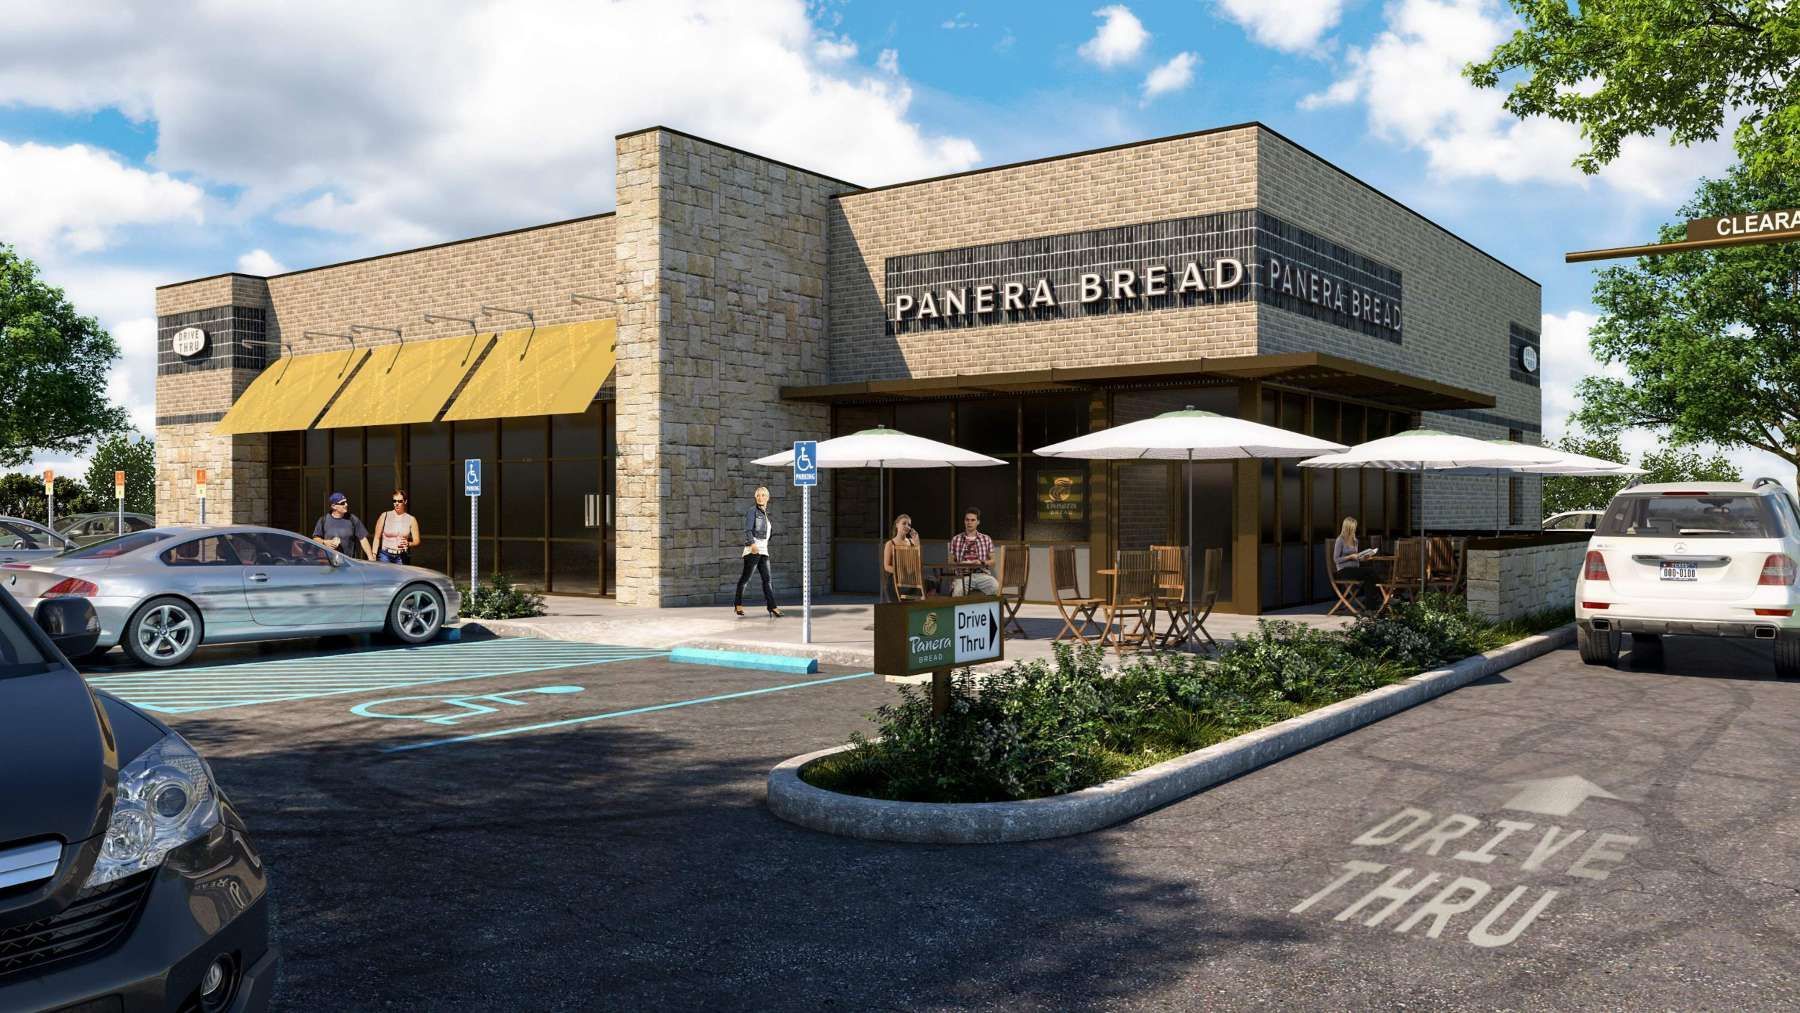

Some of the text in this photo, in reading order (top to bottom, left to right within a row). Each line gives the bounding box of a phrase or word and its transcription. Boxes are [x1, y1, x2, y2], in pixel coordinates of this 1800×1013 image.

[895, 257, 1245, 322] PANERA BREAD
[1270, 257, 1402, 331] PANERA BREAD
[178, 330, 199, 341] DRIVE
[178, 340, 199, 352] THRU
[958, 610, 987, 630] Drive
[908, 636, 952, 654] Panera
[959, 635, 985, 653] Thru
[918, 653, 943, 664] BREAD
[1350, 807, 1642, 881] DRIVE
[1289, 859, 1560, 948] THRU
